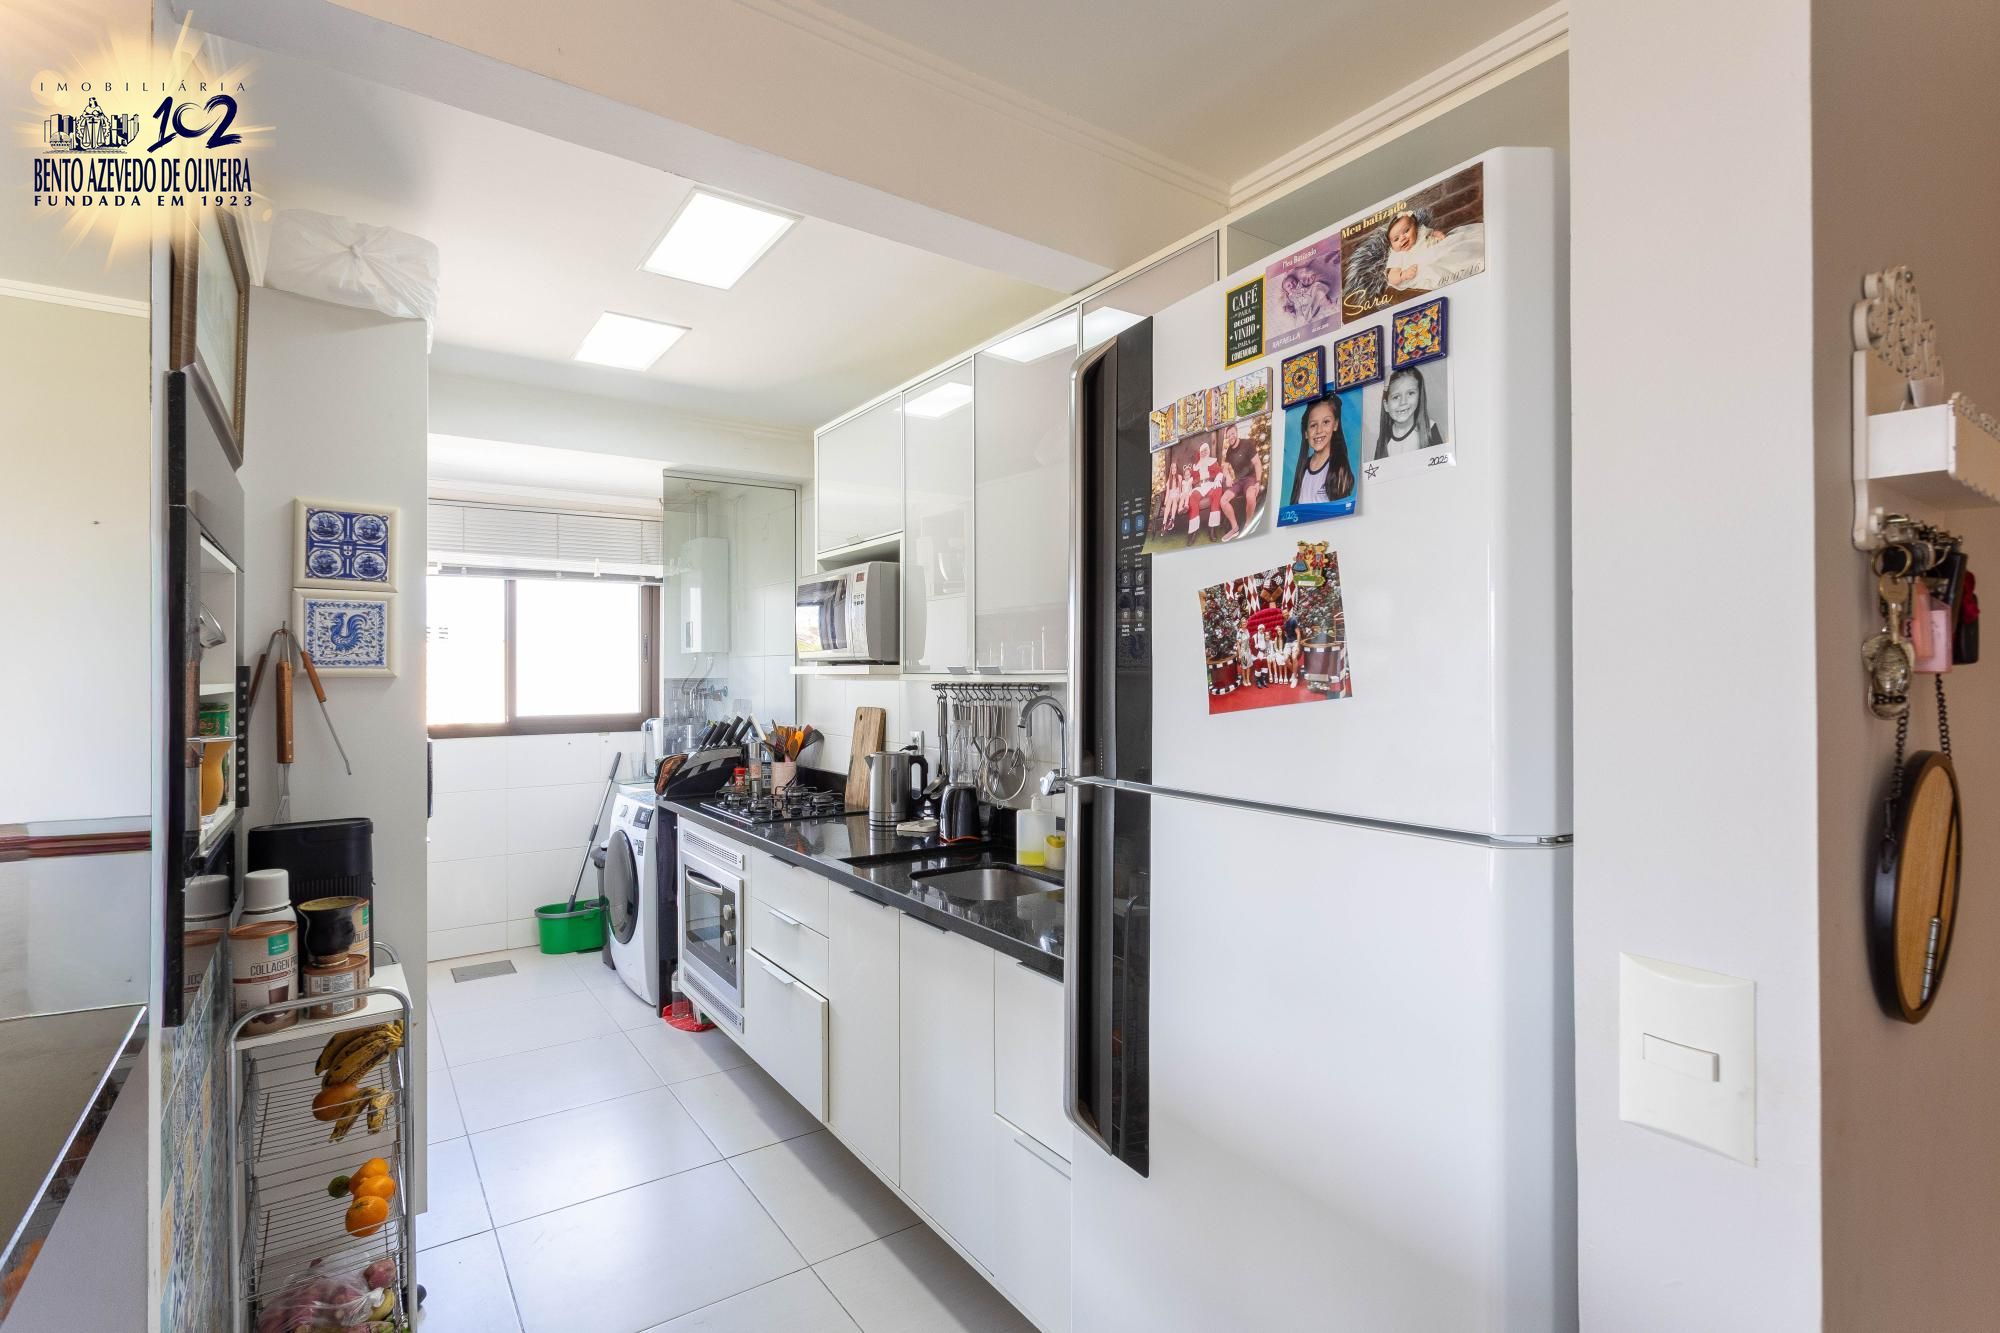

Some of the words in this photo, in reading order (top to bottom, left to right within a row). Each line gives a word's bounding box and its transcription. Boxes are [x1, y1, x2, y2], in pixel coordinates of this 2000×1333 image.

[1341, 224, 1361, 239] Meu
[1363, 201, 1407, 229] batizado
[1232, 284, 1258, 312] CAFÉ
[1344, 289, 1394, 316] Sara
[1233, 314, 1256, 329] DECIDIR
[1237, 308, 1252, 319] PARA
[1234, 323, 1256, 342] VINHO
[1237, 340, 1252, 349] PARA
[250, 959, 290, 976] COLLAGEN
